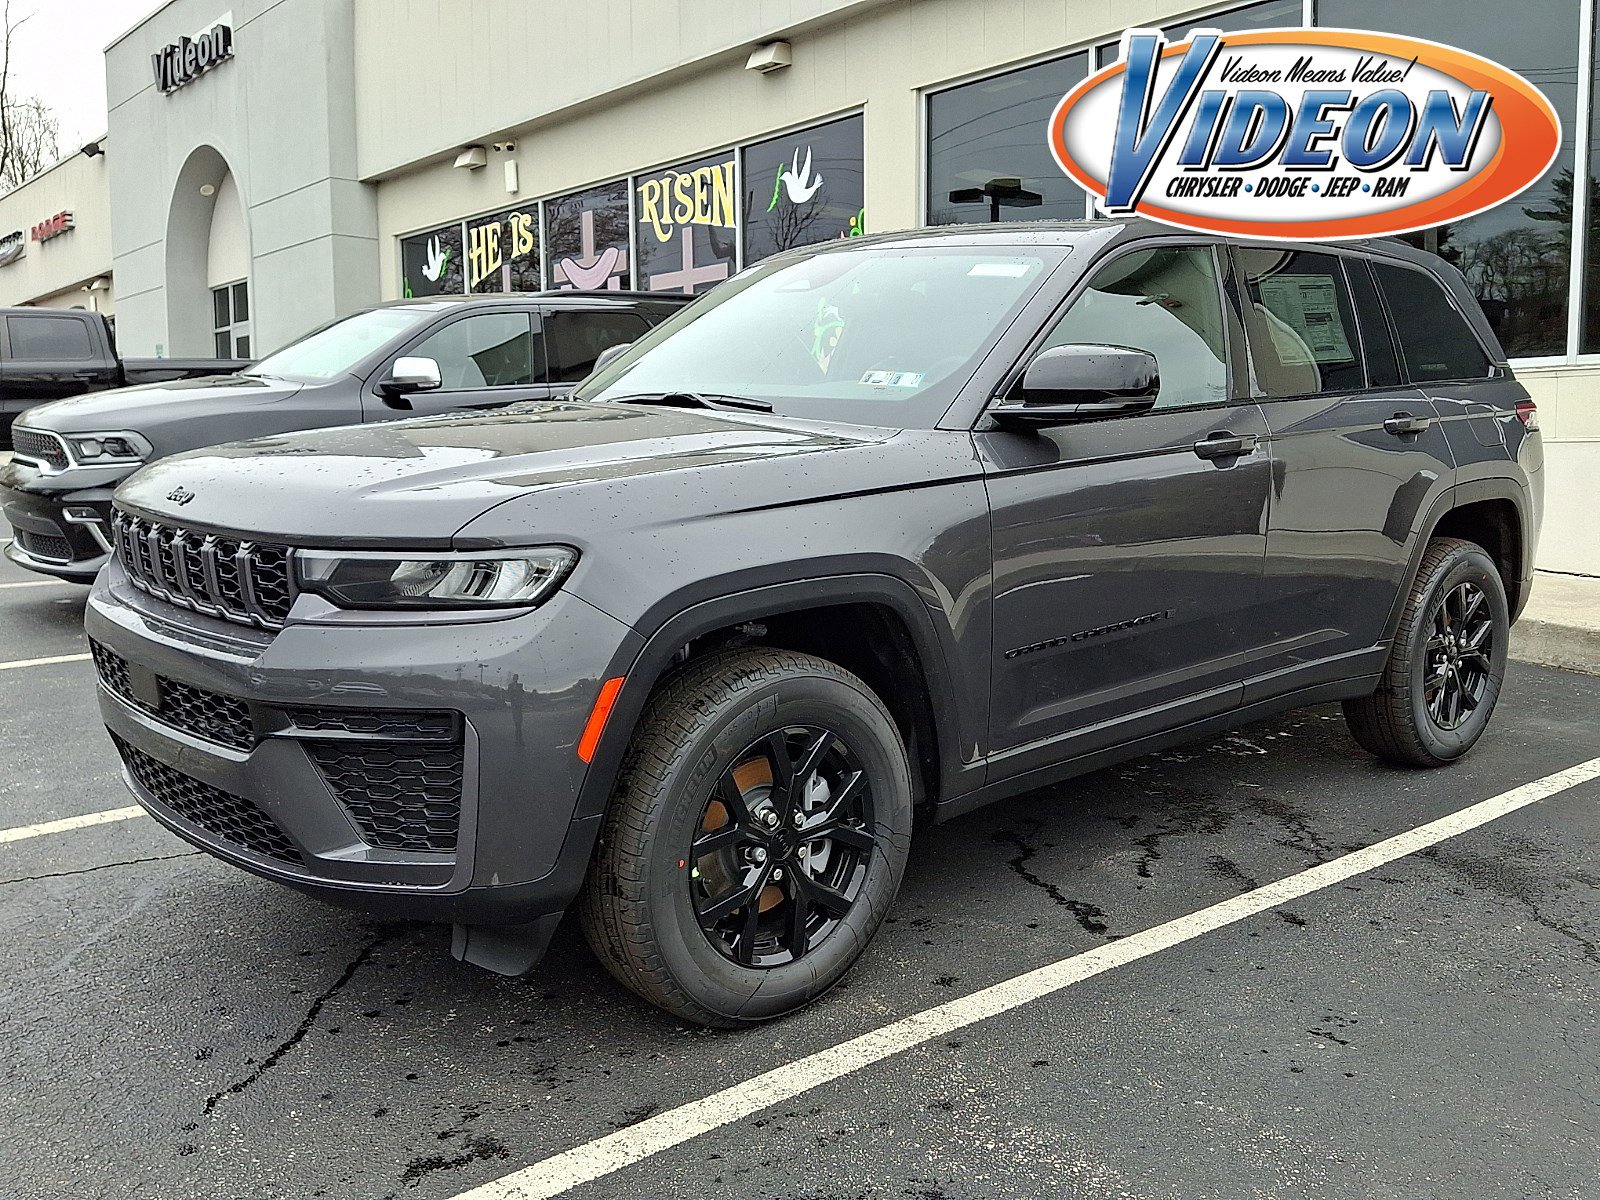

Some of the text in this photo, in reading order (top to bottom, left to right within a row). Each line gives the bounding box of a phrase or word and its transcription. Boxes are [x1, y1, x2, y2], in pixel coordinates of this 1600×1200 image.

[151, 24, 231, 93] Videon
[31, 209, 72, 242] DODGE
[469, 160, 737, 288] HE IS RISEN
[166, 485, 196, 507] Jeep
[1005, 612, 1162, 659] GRAND CHEROKEE
